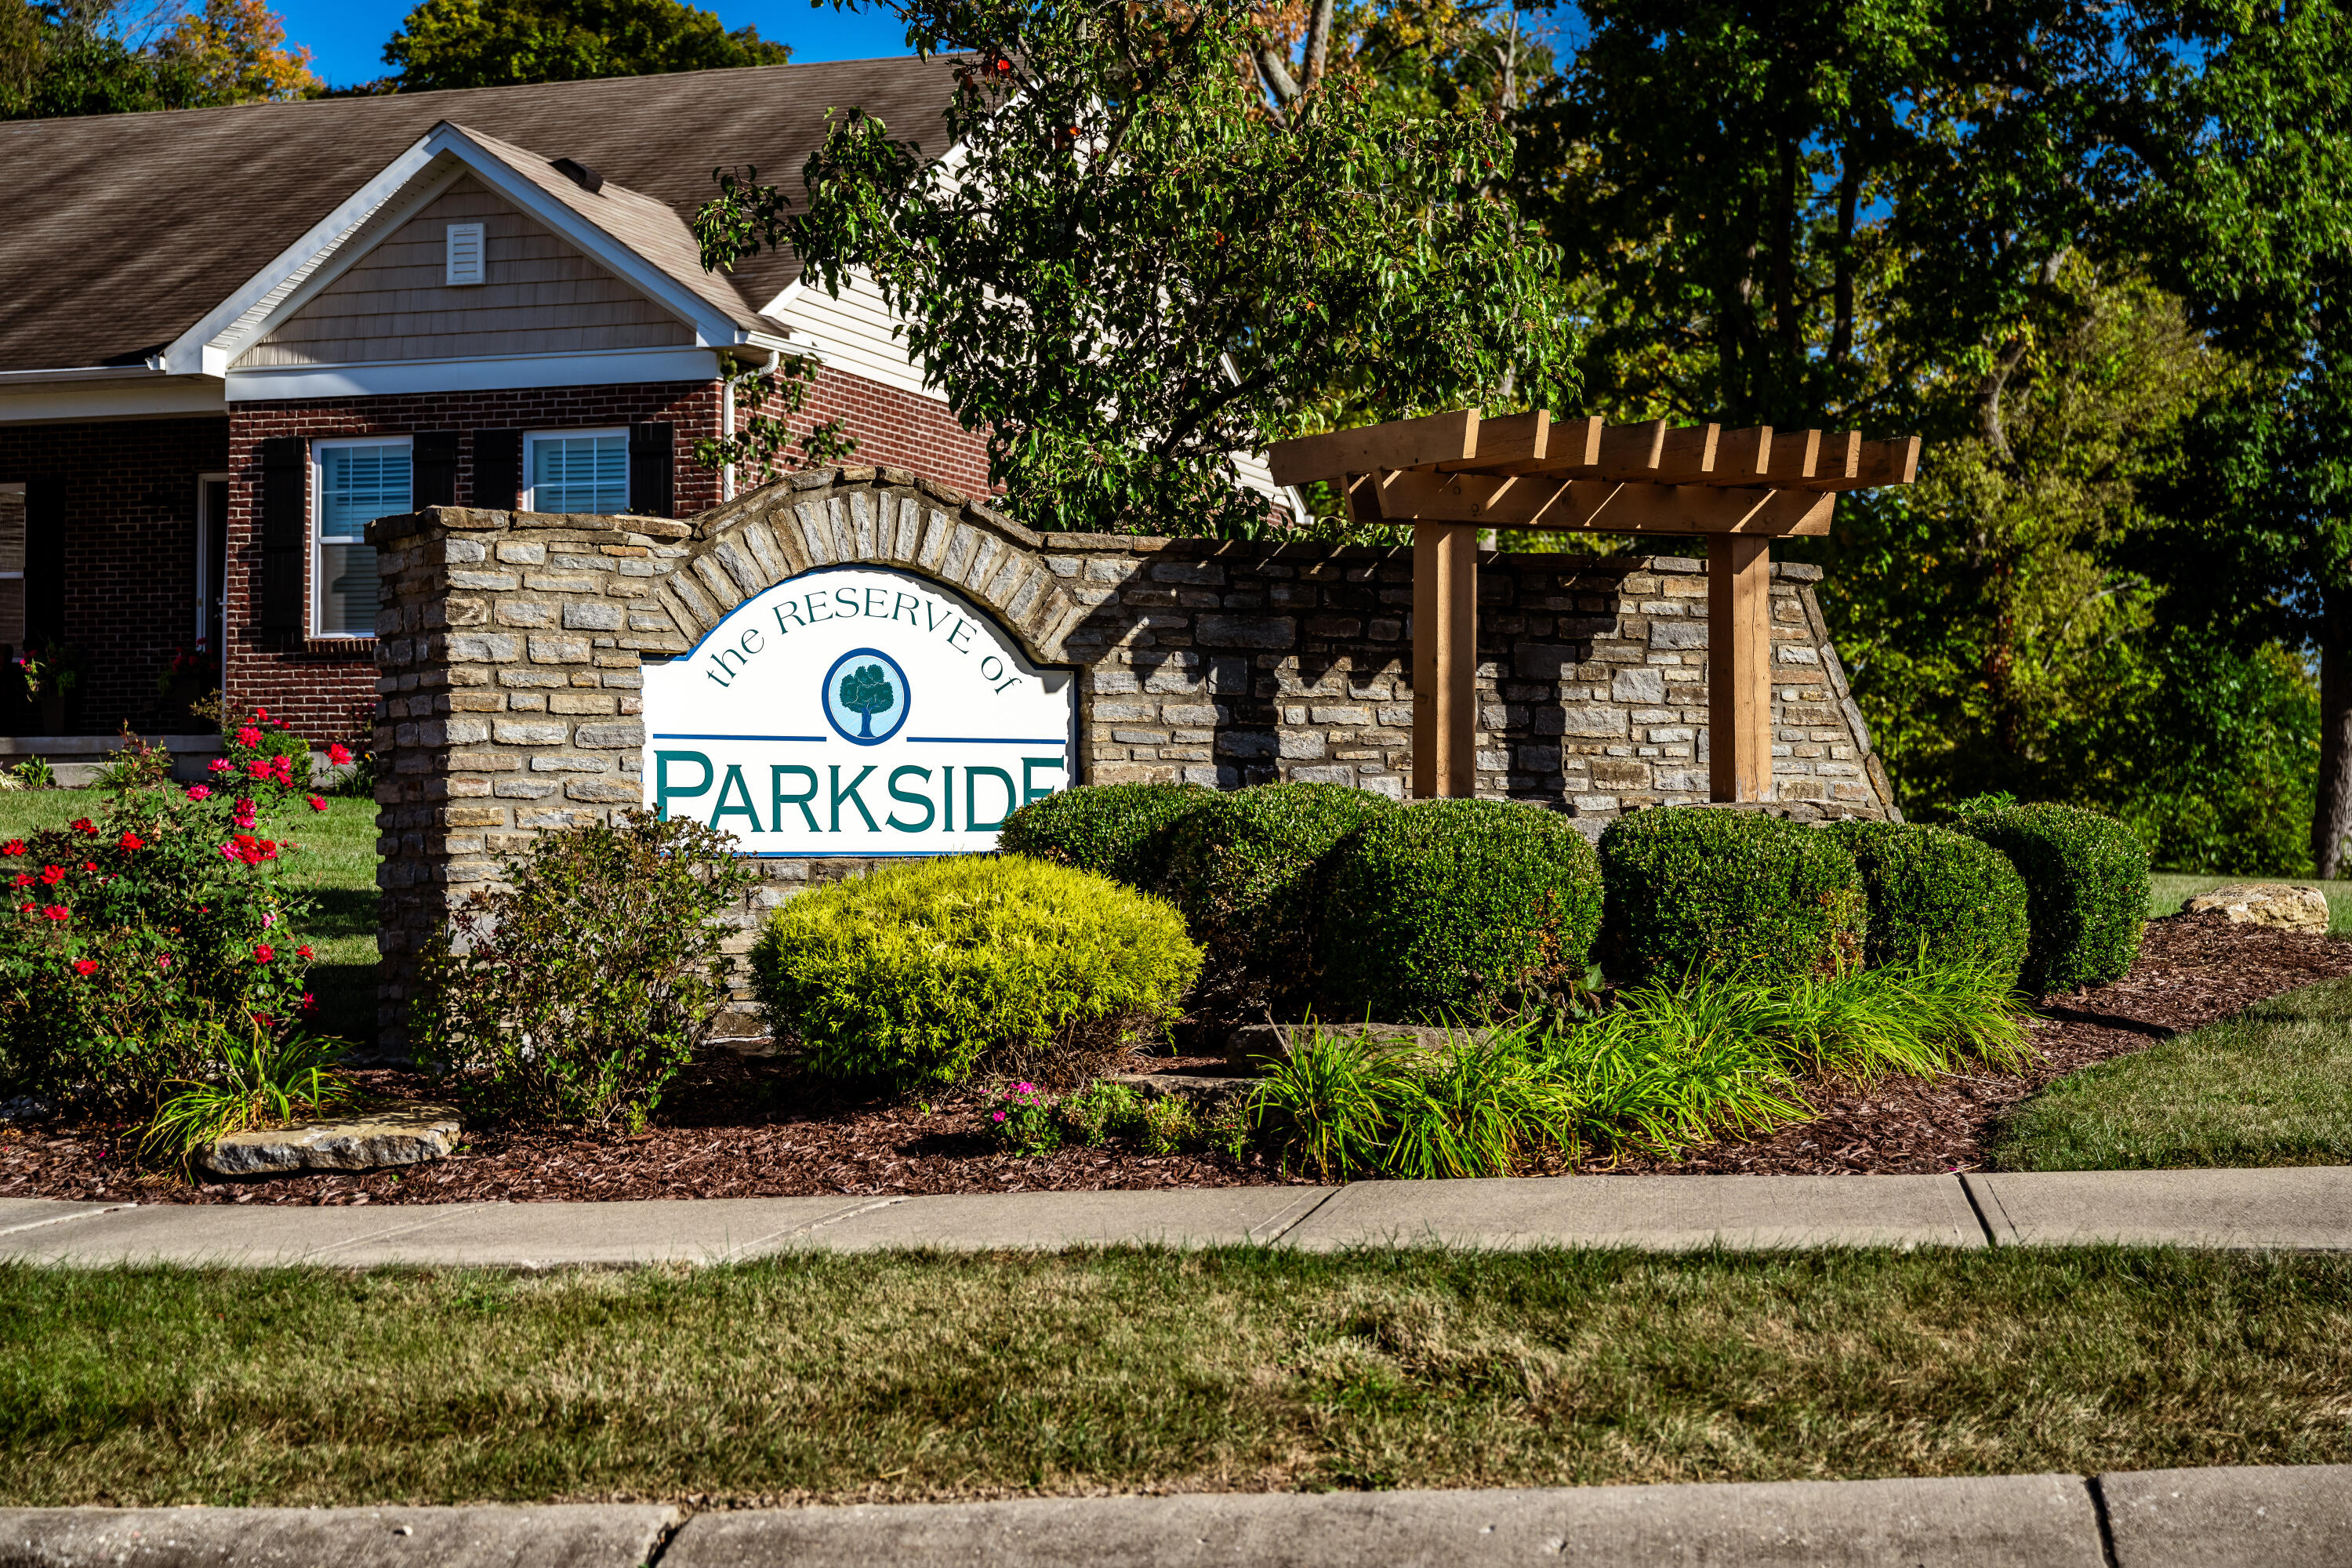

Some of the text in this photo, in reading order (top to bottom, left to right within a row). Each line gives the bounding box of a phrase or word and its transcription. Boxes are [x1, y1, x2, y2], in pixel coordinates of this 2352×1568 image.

[706, 586, 1023, 695] the RESERVE of
[653, 750, 1065, 833] PARKSIDE
